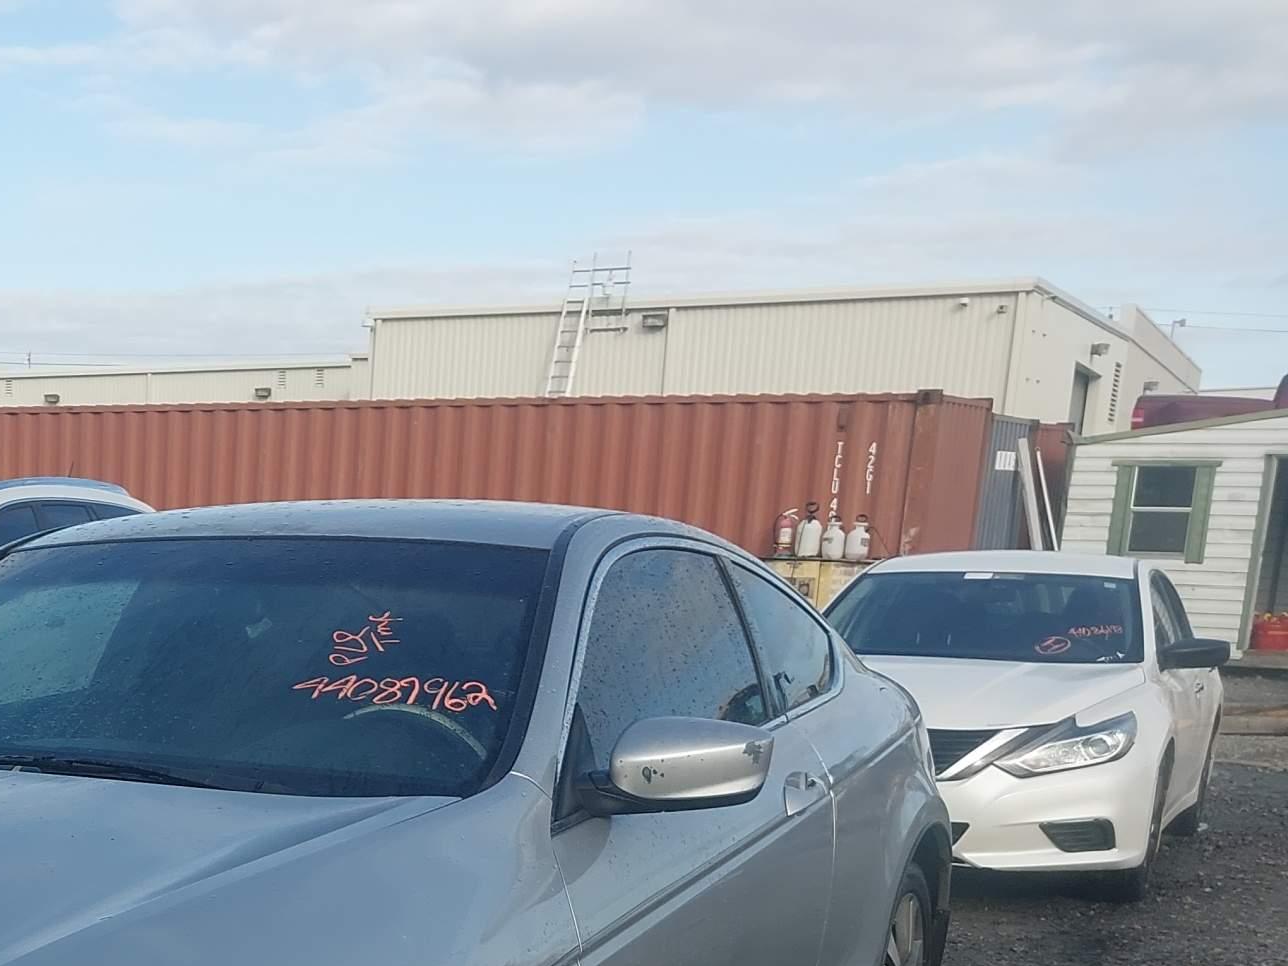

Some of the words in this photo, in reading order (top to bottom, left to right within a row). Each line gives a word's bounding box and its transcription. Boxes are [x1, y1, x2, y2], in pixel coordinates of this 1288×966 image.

[831, 441, 845, 494] TCLU
[865, 441, 877, 495] 42G1
[292, 674, 498, 712] 44087962
